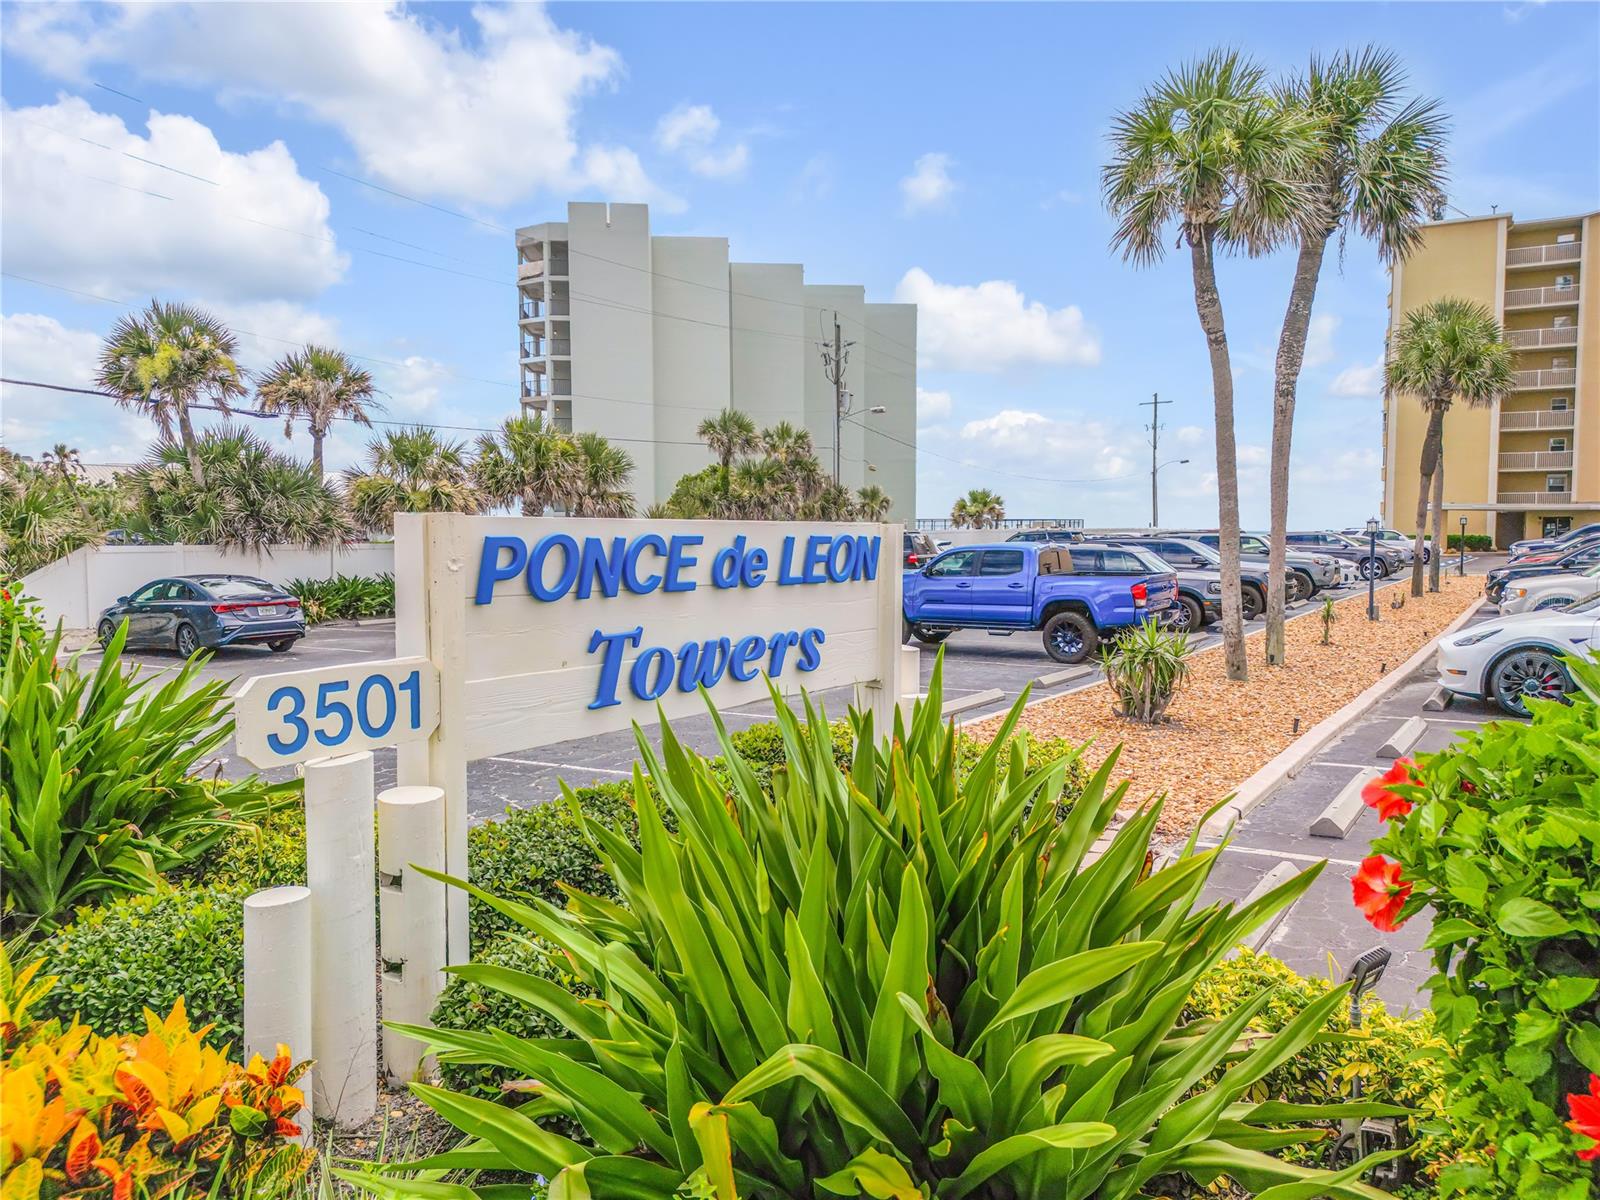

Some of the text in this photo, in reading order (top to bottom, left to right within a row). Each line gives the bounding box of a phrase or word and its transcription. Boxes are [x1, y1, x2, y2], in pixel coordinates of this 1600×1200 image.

[475, 534, 882, 606] PONCE de LEON
[586, 626, 826, 711] Towers
[265, 669, 423, 757] 3501
